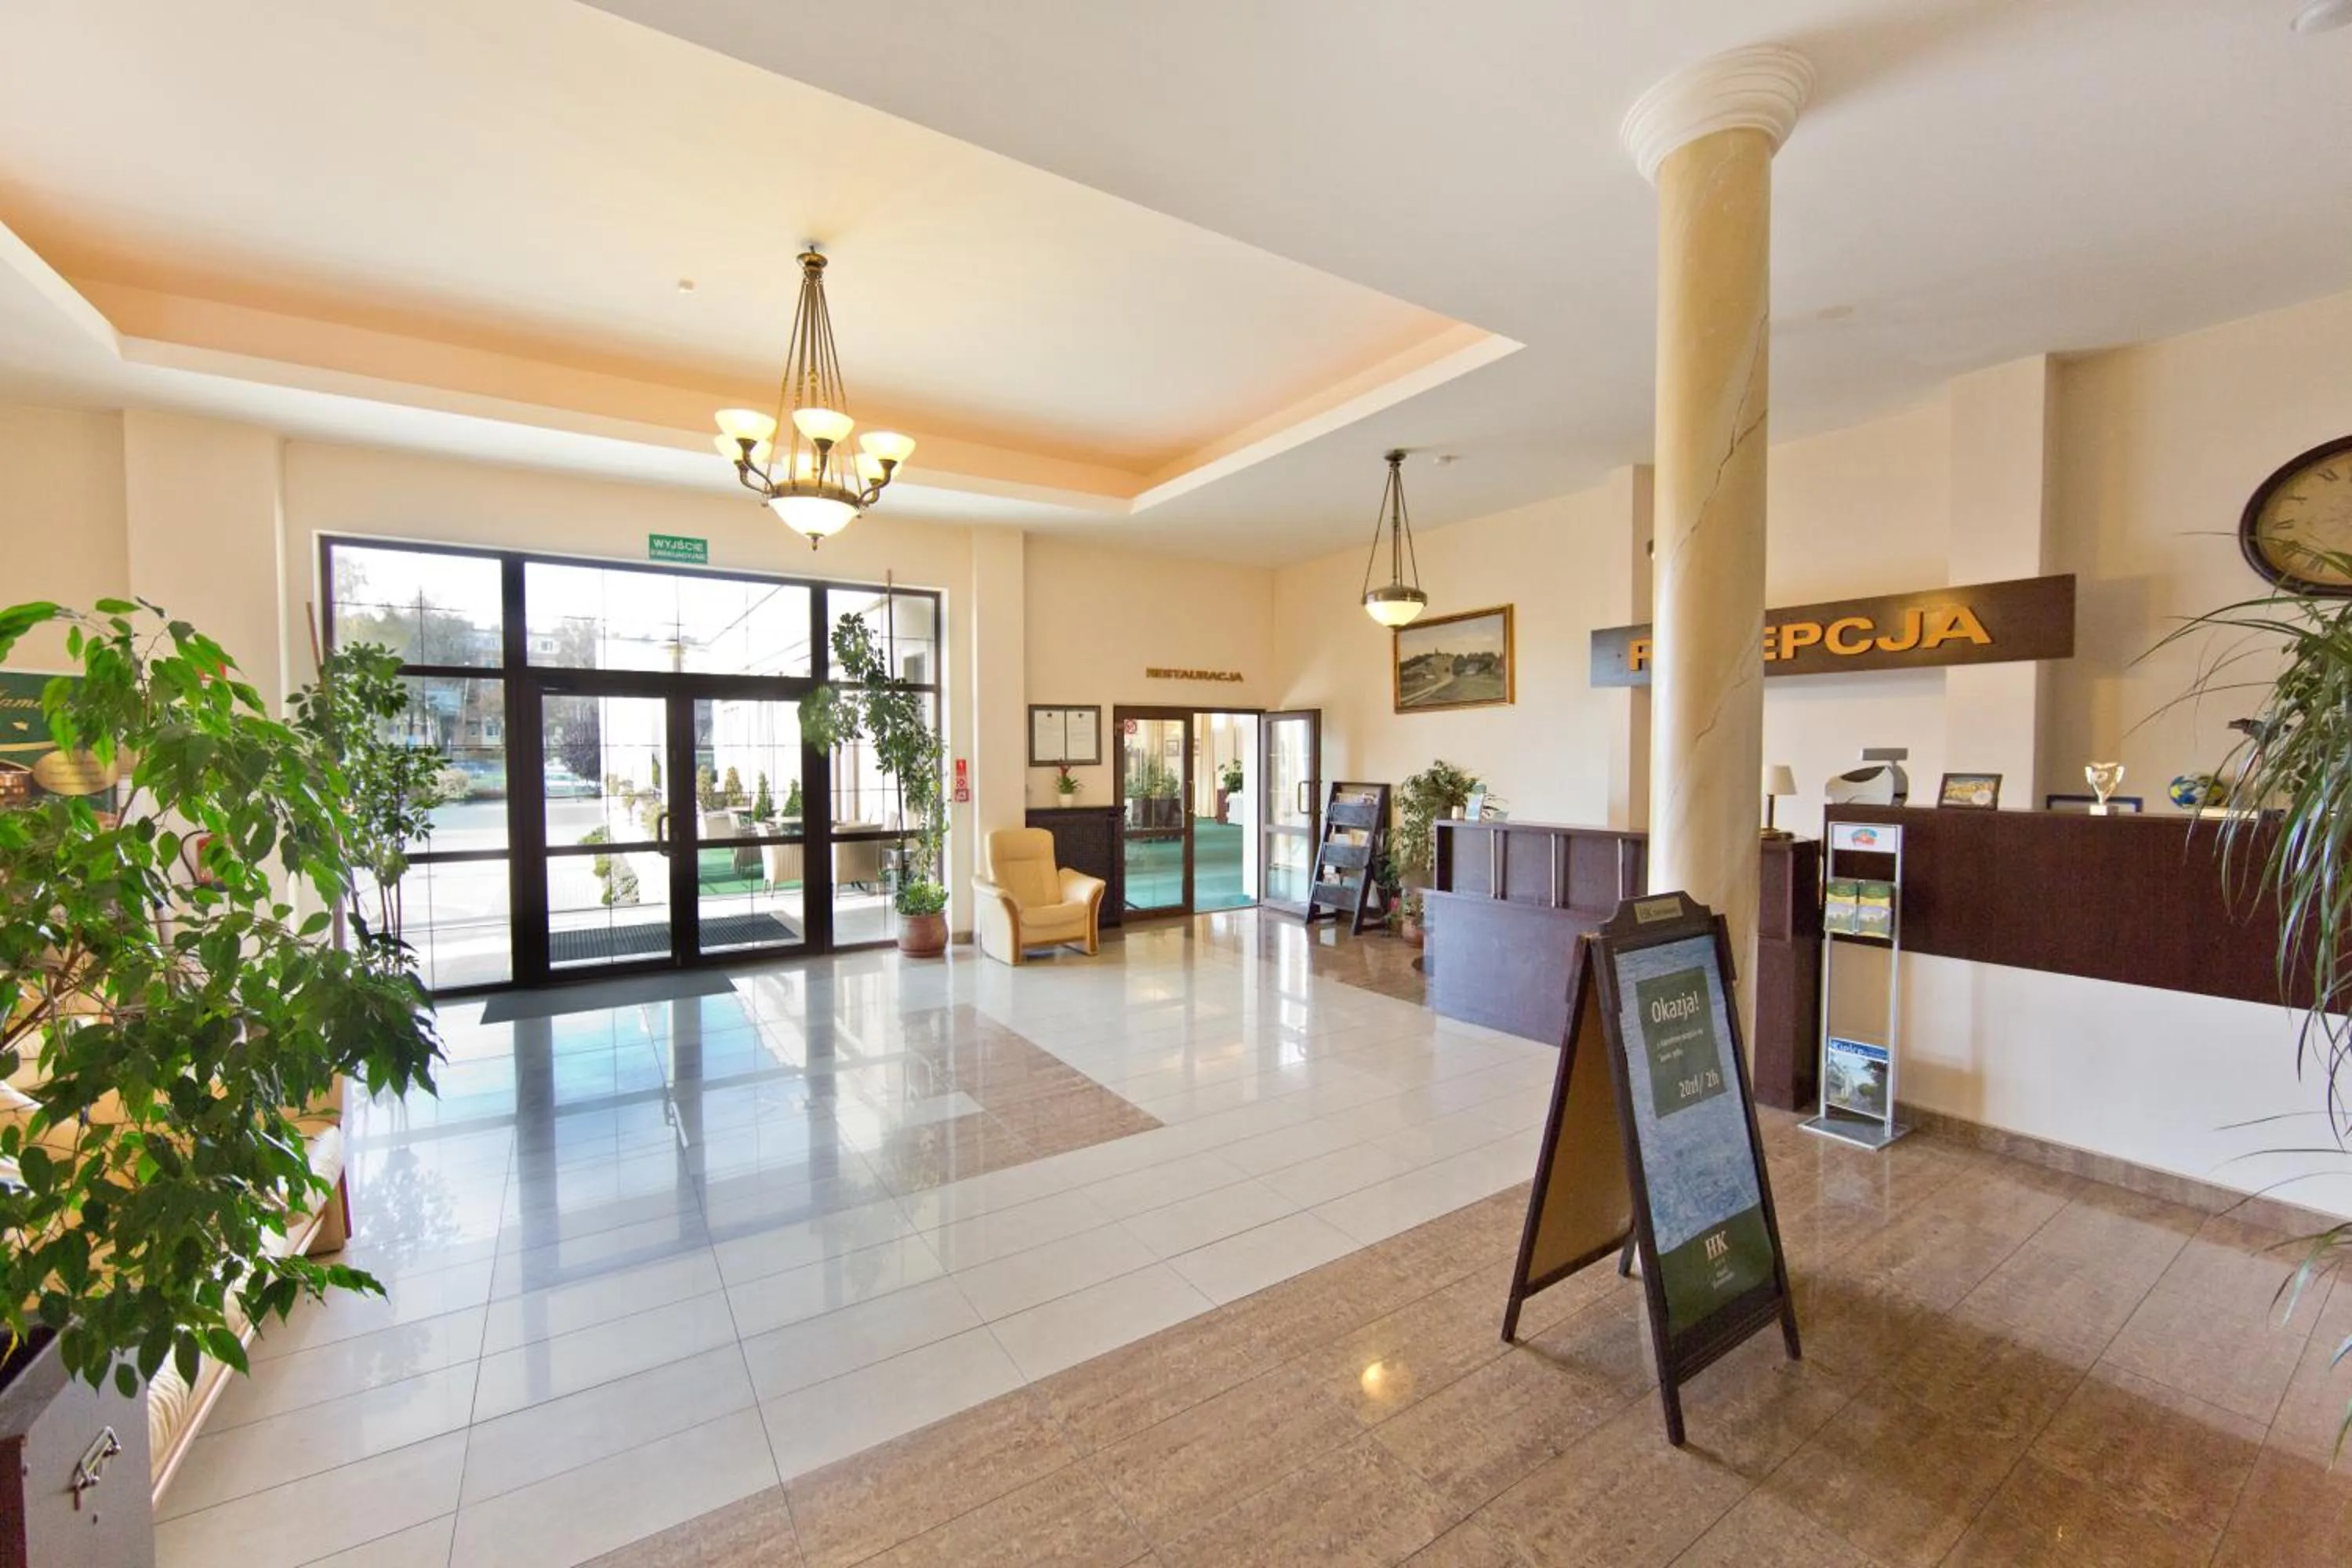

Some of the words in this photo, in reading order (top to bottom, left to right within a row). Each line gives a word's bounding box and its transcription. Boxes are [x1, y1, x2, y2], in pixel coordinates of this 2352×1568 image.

[653, 539, 703, 552] WYJŚCIE
[1630, 604, 1991, 672] RPCJA
[1651, 990, 1700, 1024] Okazja!
[1705, 1230, 1730, 1261] HK
